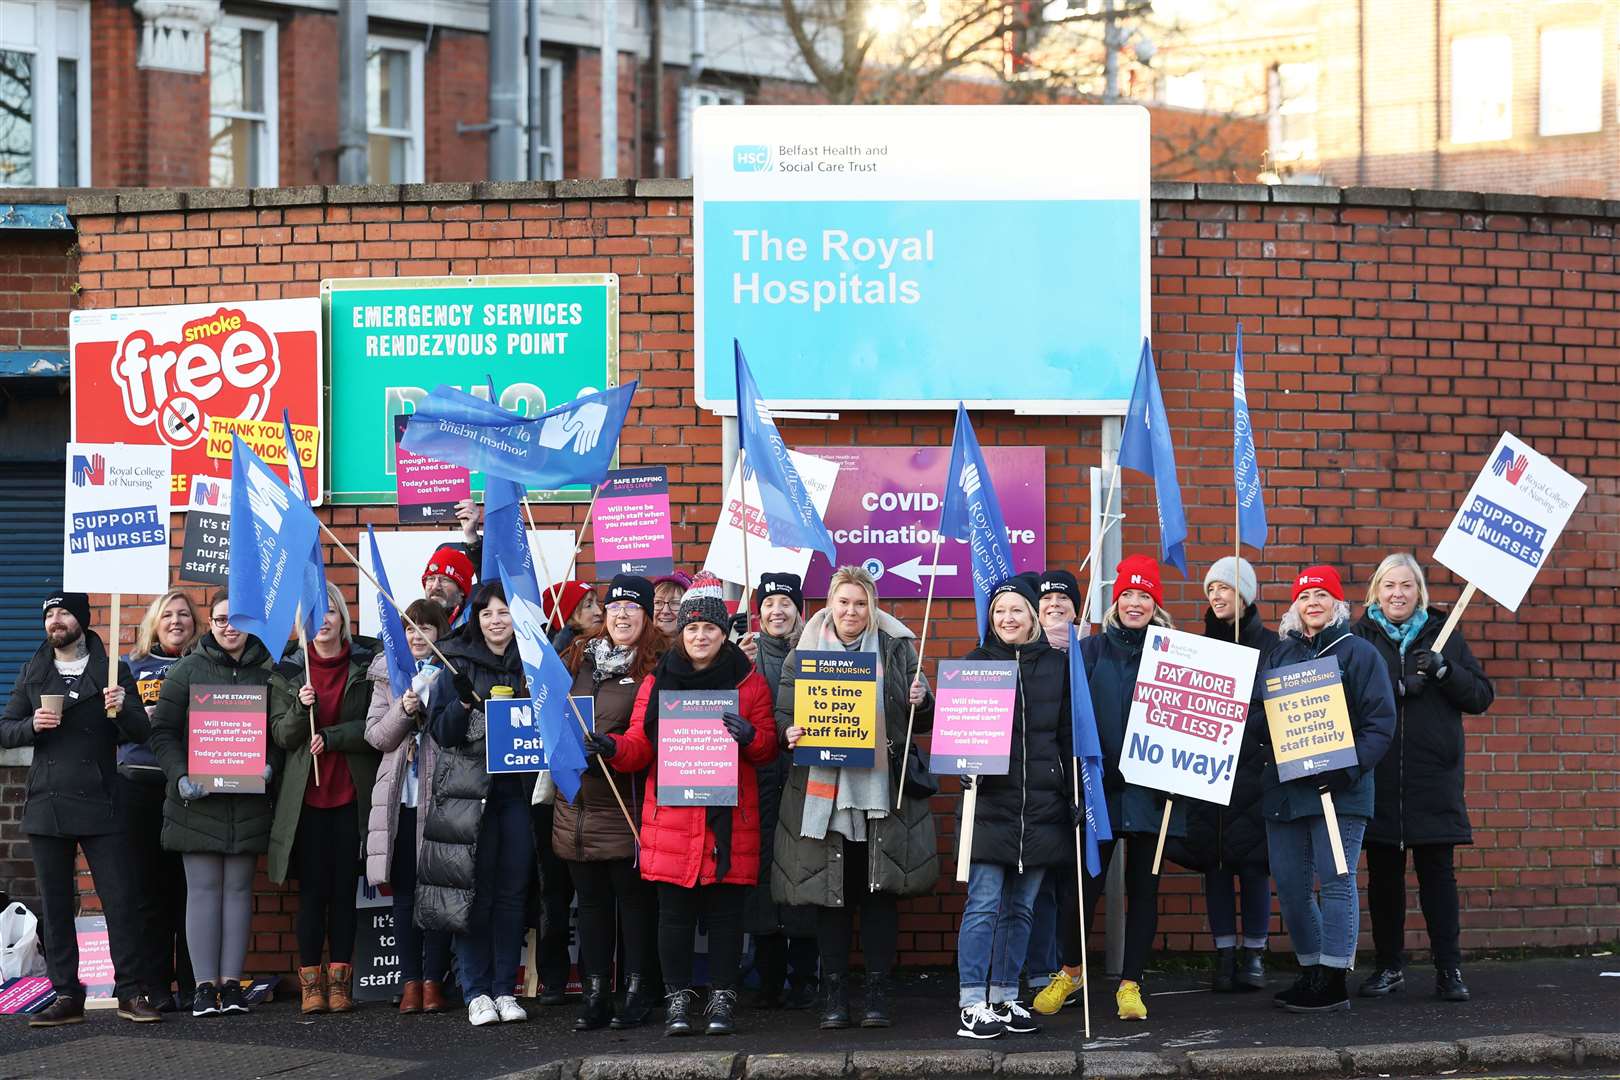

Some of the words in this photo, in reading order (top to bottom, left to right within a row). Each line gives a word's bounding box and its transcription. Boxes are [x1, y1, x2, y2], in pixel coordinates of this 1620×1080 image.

[779, 145, 818, 156] Belfast
[822, 145, 862, 156] Health
[865, 146, 888, 156] and
[737, 152, 765, 164] HSC
[779, 161, 814, 173] Social
[817, 161, 845, 173] Care
[848, 161, 878, 173] Trust
[732, 229, 808, 262] The
[822, 229, 935, 270] Royal
[732, 272, 922, 312] Hospitals
[352, 304, 474, 328] EMERGENCY
[483, 303, 583, 326] SERVICES
[184, 315, 242, 343] smoke
[366, 333, 498, 357] RENDEZVOUS
[507, 332, 569, 355] POINT
[119, 331, 269, 414] free
[212, 421, 255, 437] THANK
[259, 425, 285, 440] YOU
[210, 439, 233, 454] NO
[399, 456, 426, 466] enough
[109, 467, 133, 478] Royal
[134, 466, 166, 479] College
[405, 465, 419, 473] you
[420, 463, 439, 471] need
[109, 477, 119, 487] of
[120, 477, 153, 490] Nursing
[402, 479, 429, 488] Today's
[430, 478, 465, 487] shortages
[631, 476, 663, 484] STAFFING
[416, 486, 433, 494] cost
[434, 485, 450, 493] lives
[1524, 473, 1546, 492] Royal
[1545, 486, 1571, 510] College
[1519, 484, 1528, 494] of
[1529, 491, 1554, 514] Nursing
[644, 503, 654, 511] be
[74, 510, 157, 530] SUPPORT
[597, 513, 624, 522] enough
[624, 512, 641, 520] staff
[642, 510, 665, 519] when
[969, 501, 996, 542] Royal
[1471, 500, 1545, 544] SUPPORT
[199, 517, 218, 531] It's
[604, 521, 619, 529] you
[619, 519, 640, 527] need
[640, 518, 659, 526] care?
[70, 536, 89, 551] NI
[94, 528, 166, 548] NURSES
[203, 533, 216, 544] to
[600, 535, 629, 545] Today's
[629, 533, 665, 543] shortages
[1458, 514, 1476, 532] NI
[1479, 525, 1541, 564] NURSES
[616, 543, 633, 551] cost
[634, 541, 650, 550] lives
[196, 548, 230, 561] nursi
[969, 528, 999, 586] Nursing
[185, 561, 217, 573] staff
[836, 667, 872, 675] NURSING
[1282, 673, 1301, 682] FAIR
[1301, 668, 1318, 677] PAY
[1159, 667, 1187, 684] PAY
[1190, 674, 1234, 696] MORE
[1283, 680, 1301, 689] FOR
[1300, 672, 1336, 687] NURSING
[807, 685, 829, 697] It's
[831, 686, 863, 698] time
[813, 700, 825, 711] to
[827, 700, 856, 714] pay
[951, 697, 967, 705] Will
[967, 697, 987, 705] there
[988, 697, 999, 705] be
[1137, 685, 1182, 708] WORK
[1187, 696, 1245, 720] LONGER
[1279, 700, 1299, 713] It's
[1300, 693, 1331, 708] time
[940, 706, 966, 715] enough
[967, 705, 986, 713] staff
[988, 705, 1009, 713] when
[204, 720, 219, 728] Will
[220, 720, 241, 728] there
[808, 713, 861, 727] nursing
[946, 715, 962, 723] you
[1287, 713, 1301, 724] to
[1303, 709, 1328, 726] pay
[192, 728, 222, 736] enough
[241, 728, 262, 736] when
[673, 728, 689, 736] Will
[690, 728, 711, 736] there
[712, 728, 723, 736] be
[801, 726, 831, 738] staff
[833, 726, 869, 741] fairly
[940, 729, 967, 738] Today's
[968, 729, 1005, 738] shortages
[1149, 708, 1179, 726] GET
[1181, 715, 1234, 746] LESS?
[1285, 718, 1336, 739] nursing
[214, 735, 235, 743] need
[513, 737, 544, 750] Pati
[661, 736, 690, 745] enough
[690, 735, 710, 743] staff
[711, 735, 734, 743] when
[971, 737, 988, 745] lives
[1280, 739, 1310, 753] staff
[1311, 730, 1346, 749] fairly
[669, 744, 685, 752] you
[686, 743, 708, 751] need
[708, 743, 727, 751] care?
[194, 750, 222, 759] Today's
[223, 751, 261, 759] shortages
[503, 752, 540, 766] Care
[1127, 732, 1165, 765] No
[1171, 748, 1235, 786] way!
[663, 760, 694, 769] Today's
[694, 760, 733, 769] shortages
[698, 767, 716, 775] lives
[380, 935, 396, 947] to
[360, 970, 401, 987] staff
